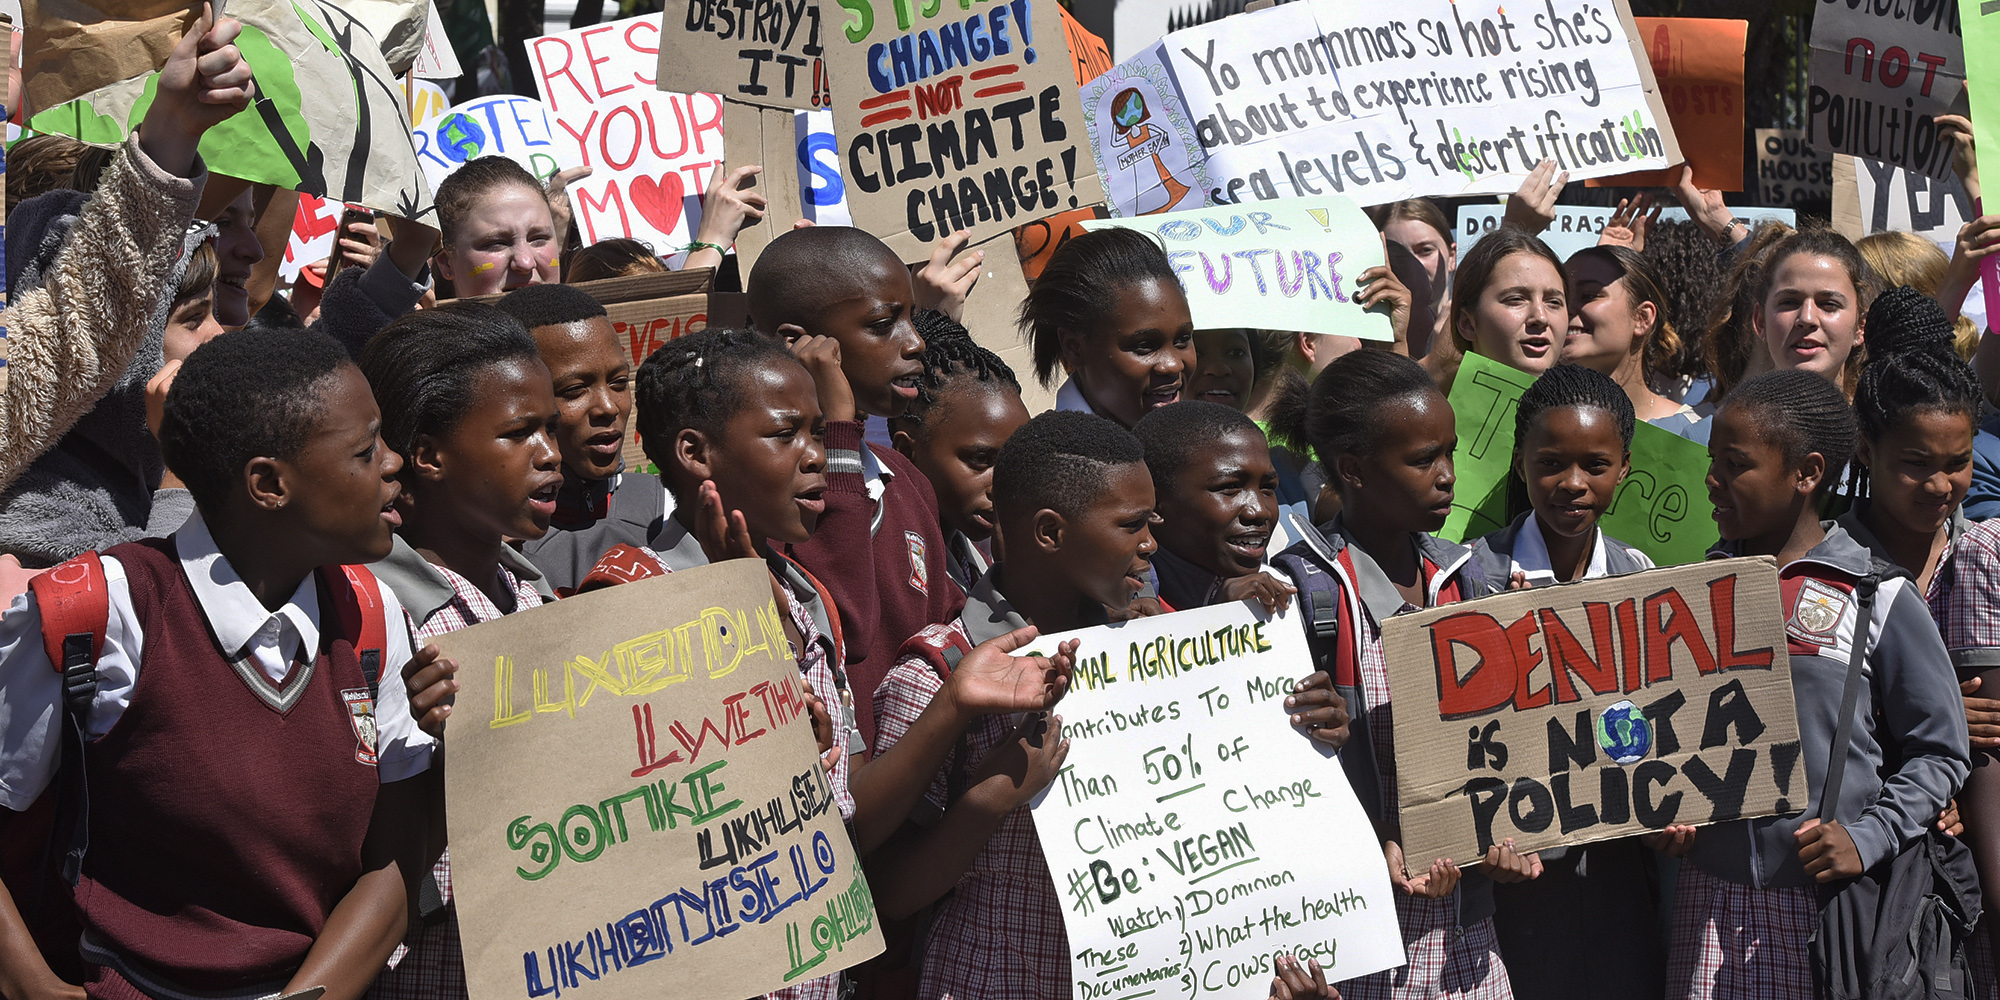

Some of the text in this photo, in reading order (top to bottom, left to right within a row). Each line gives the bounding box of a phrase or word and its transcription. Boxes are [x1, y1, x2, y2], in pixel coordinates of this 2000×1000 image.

[867, 0, 1038, 94] CHANGE!
[1181, 38, 1241, 96] Yo
[1252, 21, 1417, 86] momma's
[1418, 18, 1453, 57] so
[1452, 1, 1521, 58] hot
[1534, 0, 1612, 51] she's
[557, 91, 724, 168] YOUR
[914, 75, 964, 121] NOT
[1197, 58, 1601, 149] about to experience rising
[1806, 84, 1956, 184] Pollution
[906, 145, 1079, 243] CHANGE!
[1211, 168, 1280, 206] sea
[1277, 130, 1407, 198] levels
[1436, 109, 1665, 176] desertification
[1156, 211, 1292, 241] OUR
[1167, 248, 1350, 304] FUTURE
[1128, 620, 1273, 686] AGRICULTURE
[1422, 573, 1774, 722] DENIAL
[1060, 700, 1182, 742] ontributes
[1198, 686, 1230, 717] To
[1700, 679, 1768, 752] A
[1056, 733, 1250, 808] Than 50% of
[1444, 740, 1803, 856] POLICY!
[1074, 776, 1322, 855] Climate Change
[1156, 822, 1256, 876] VEGAN
[1076, 942, 1139, 969] These
[1195, 915, 1258, 954] What
[1261, 903, 1302, 933] the
[1301, 888, 1368, 923] health
[1106, 904, 1173, 938] Watch
[1185, 869, 1295, 917] Dominion
